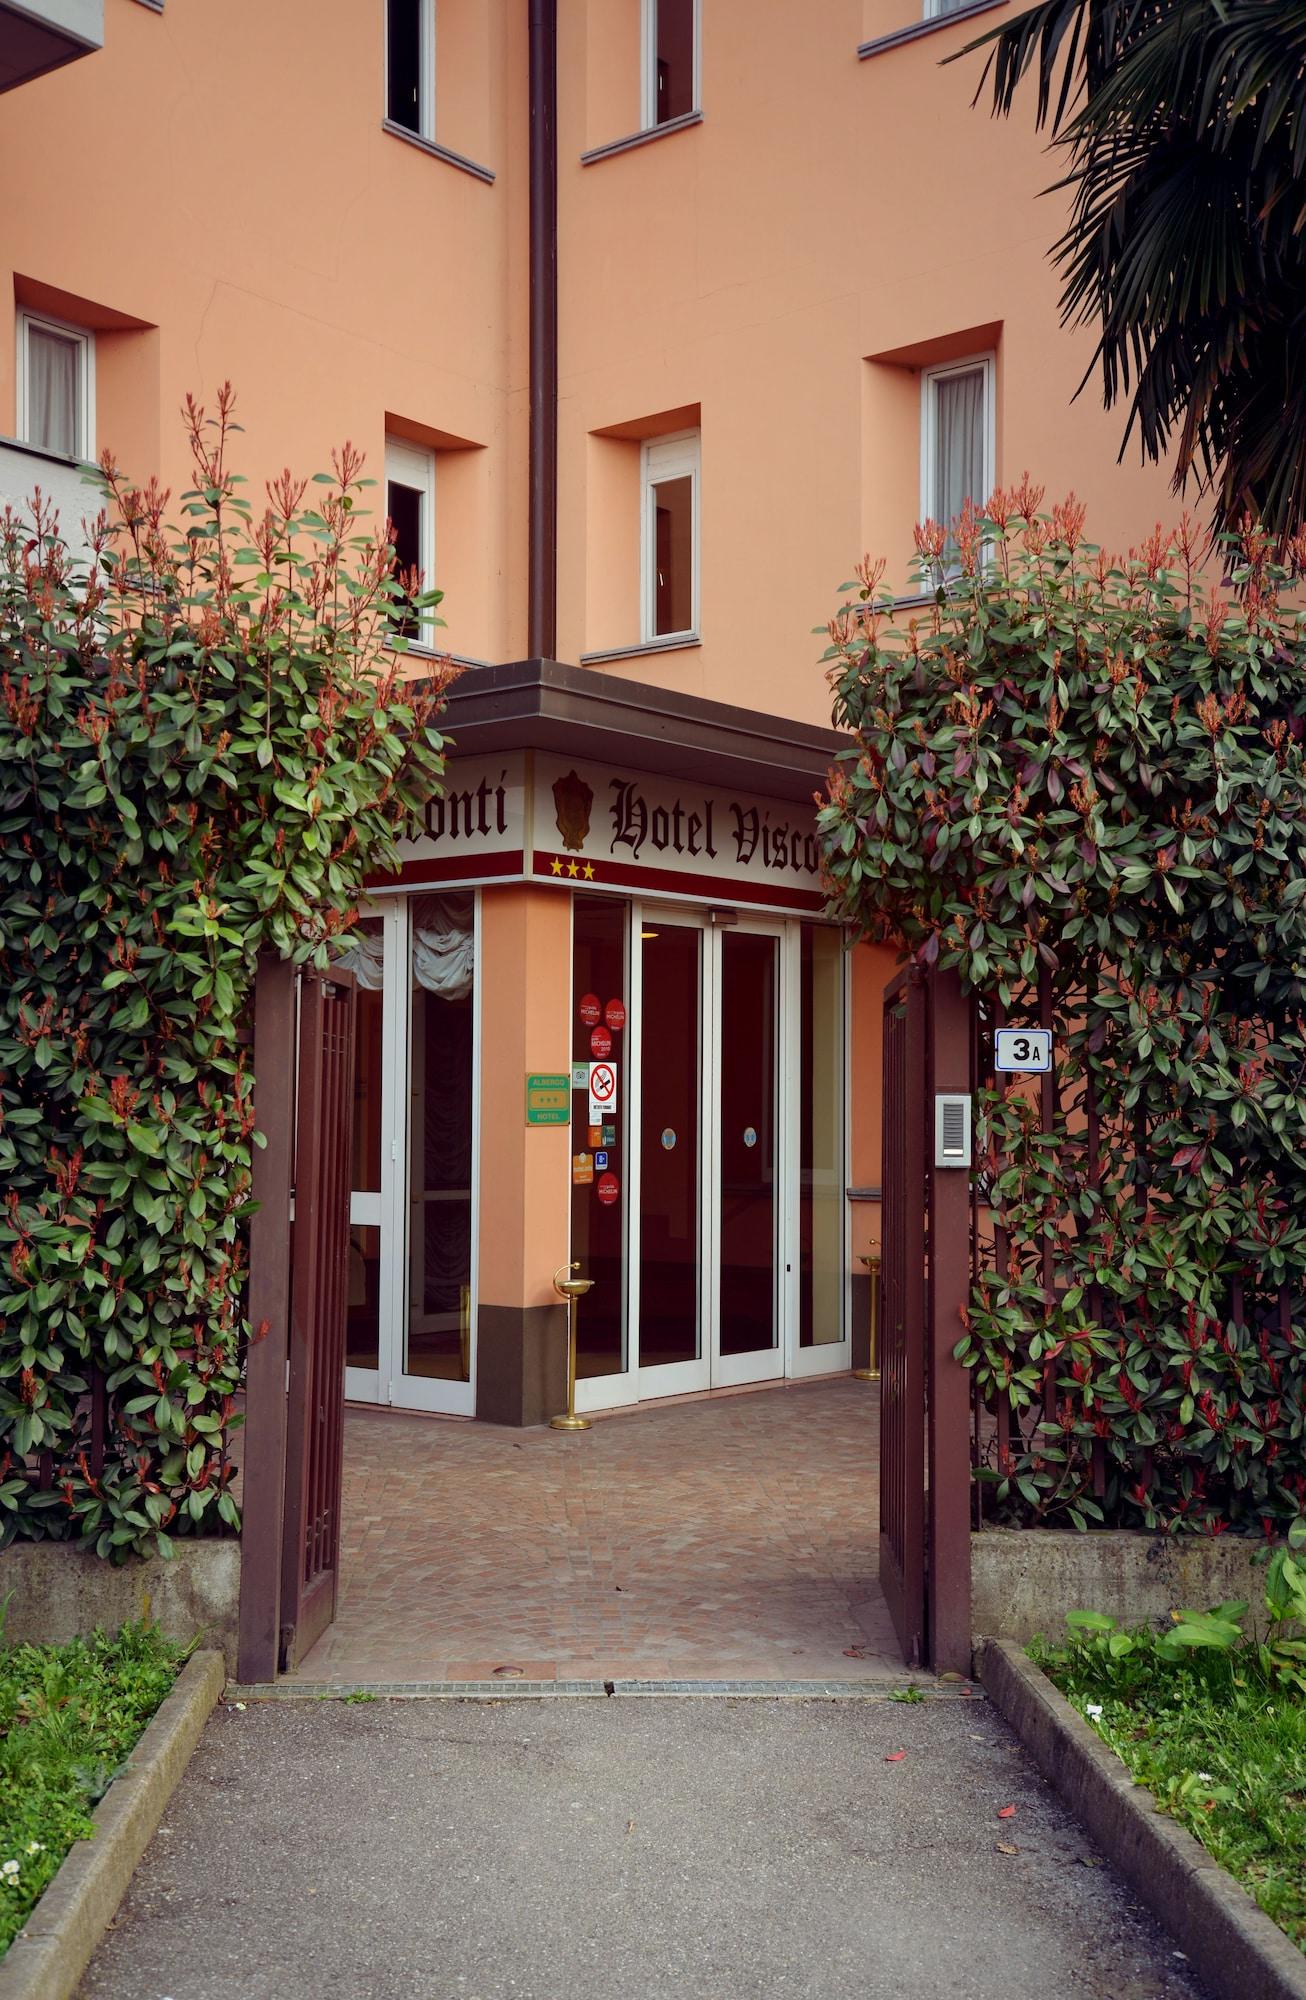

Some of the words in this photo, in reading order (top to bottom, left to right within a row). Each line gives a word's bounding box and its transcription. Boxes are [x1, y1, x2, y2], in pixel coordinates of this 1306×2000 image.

[608, 777, 719, 861] Hotel
[729, 802, 820, 875] Visco
[1013, 1038, 1041, 1061] 3A
[533, 1078, 565, 1087] ALBERGO
[536, 1113, 560, 1121] HOTEL
